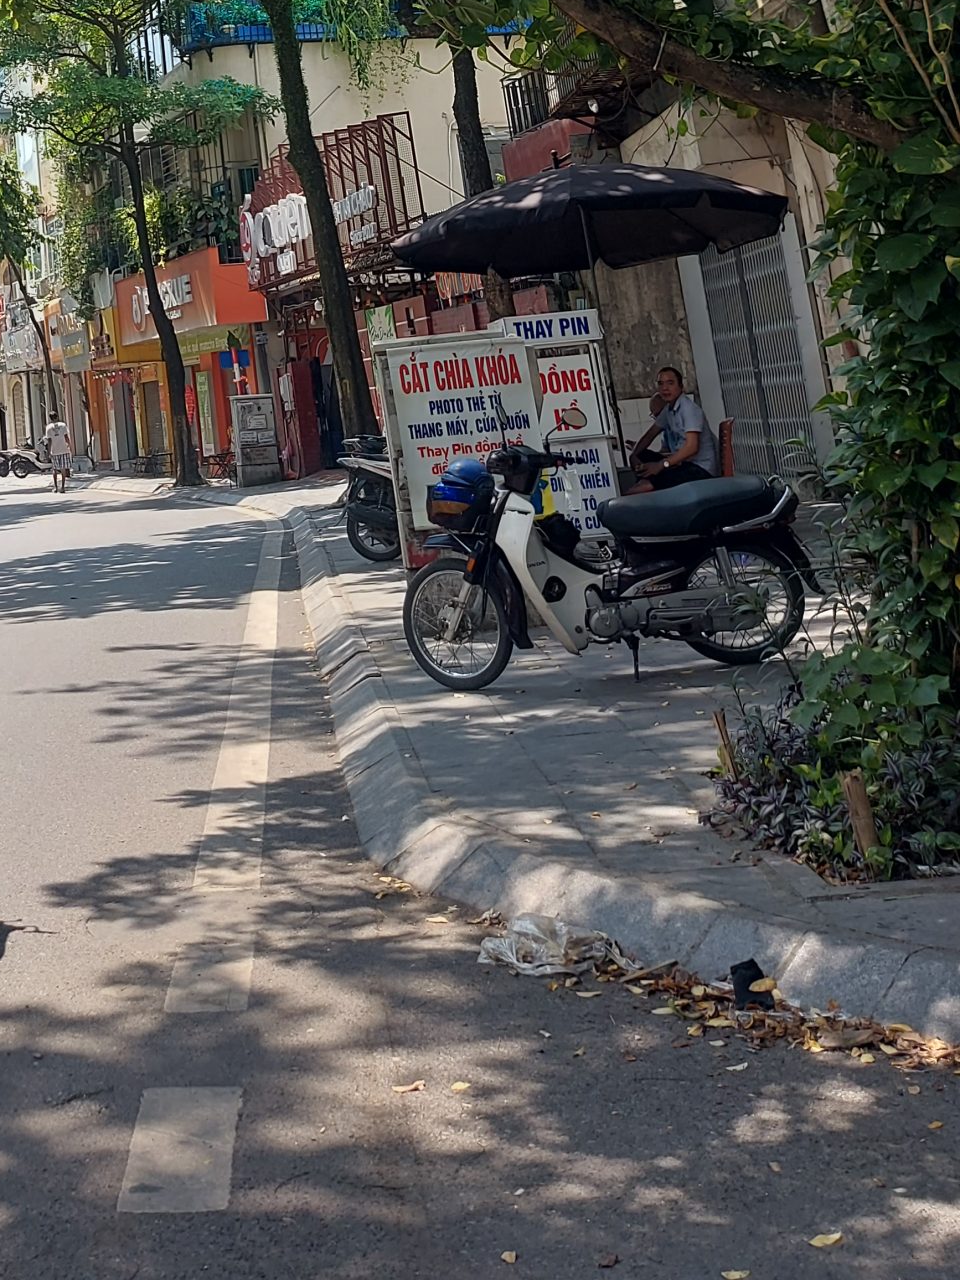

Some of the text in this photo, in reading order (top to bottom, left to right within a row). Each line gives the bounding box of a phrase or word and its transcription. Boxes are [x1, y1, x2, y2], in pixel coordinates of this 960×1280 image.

[513, 316, 590, 340] THAY PIN
[399, 348, 522, 395] CẮT CHÌA KHÓA
[428, 397, 464, 415] PHOTO
[466, 389, 487, 412] THẺ
[553, 399, 587, 431] H
[408, 421, 444, 440] THANG
[476, 411, 498, 433] CỬA
[417, 443, 449, 458] Thay
[452, 442, 473, 456] Pin
[582, 494, 598, 511] TÔ
